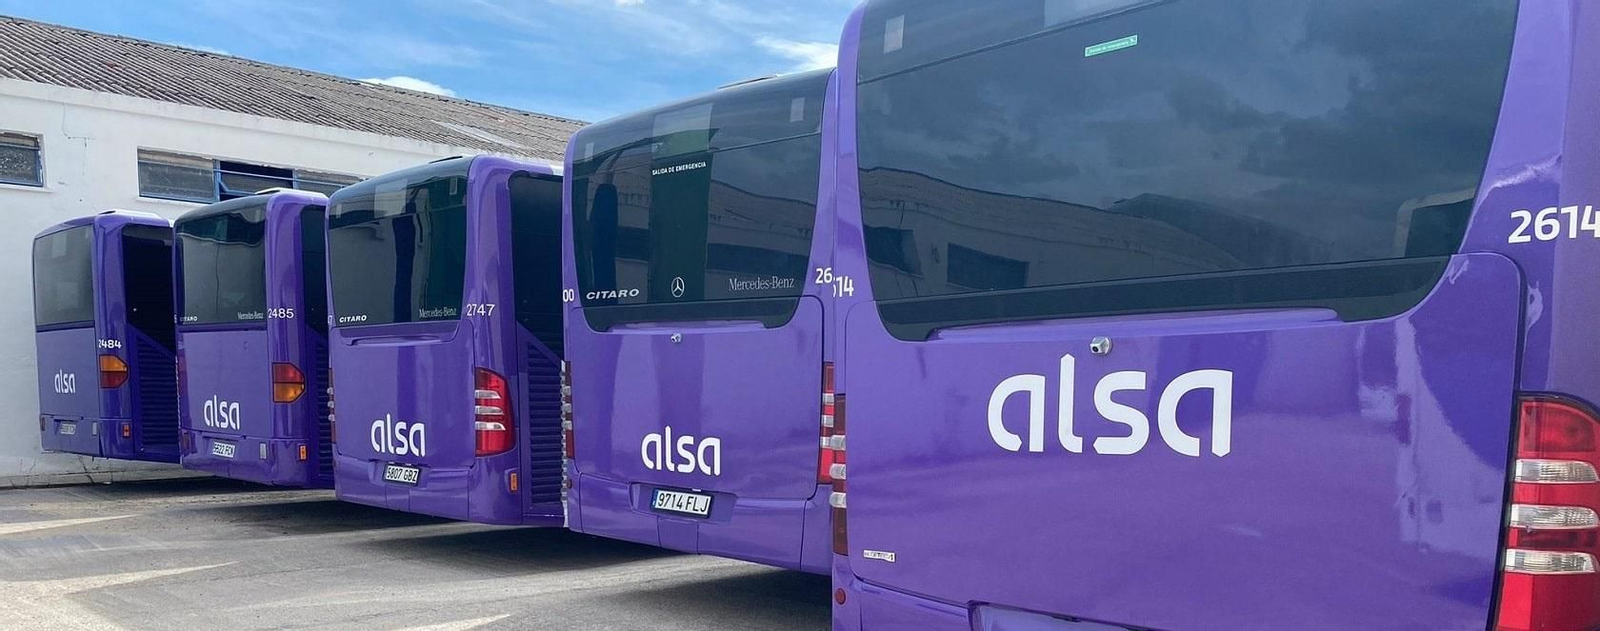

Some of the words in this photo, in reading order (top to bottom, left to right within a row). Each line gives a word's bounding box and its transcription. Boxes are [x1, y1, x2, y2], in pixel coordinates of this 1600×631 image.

[652, 168, 668, 176] SALIDA
[675, 161, 707, 172] EMERGENCIA
[1508, 205, 1600, 243] 2614
[729, 276, 795, 291] Mercedes-Benz
[586, 289, 640, 300] CITARO
[268, 308, 294, 319] 2485
[419, 307, 457, 318] Mercedes-Benz
[466, 303, 496, 317] 2747
[339, 315, 368, 323] CITARO
[98, 339, 122, 349] 2484
[54, 369, 76, 394] alsa
[204, 395, 240, 430] alsa
[987, 354, 1233, 457] alsa
[371, 414, 426, 457] alsa
[642, 426, 721, 476] alsa
[404, 469, 418, 482] GBZ
[658, 492, 684, 510] 9714
[685, 495, 710, 512] FLJ
